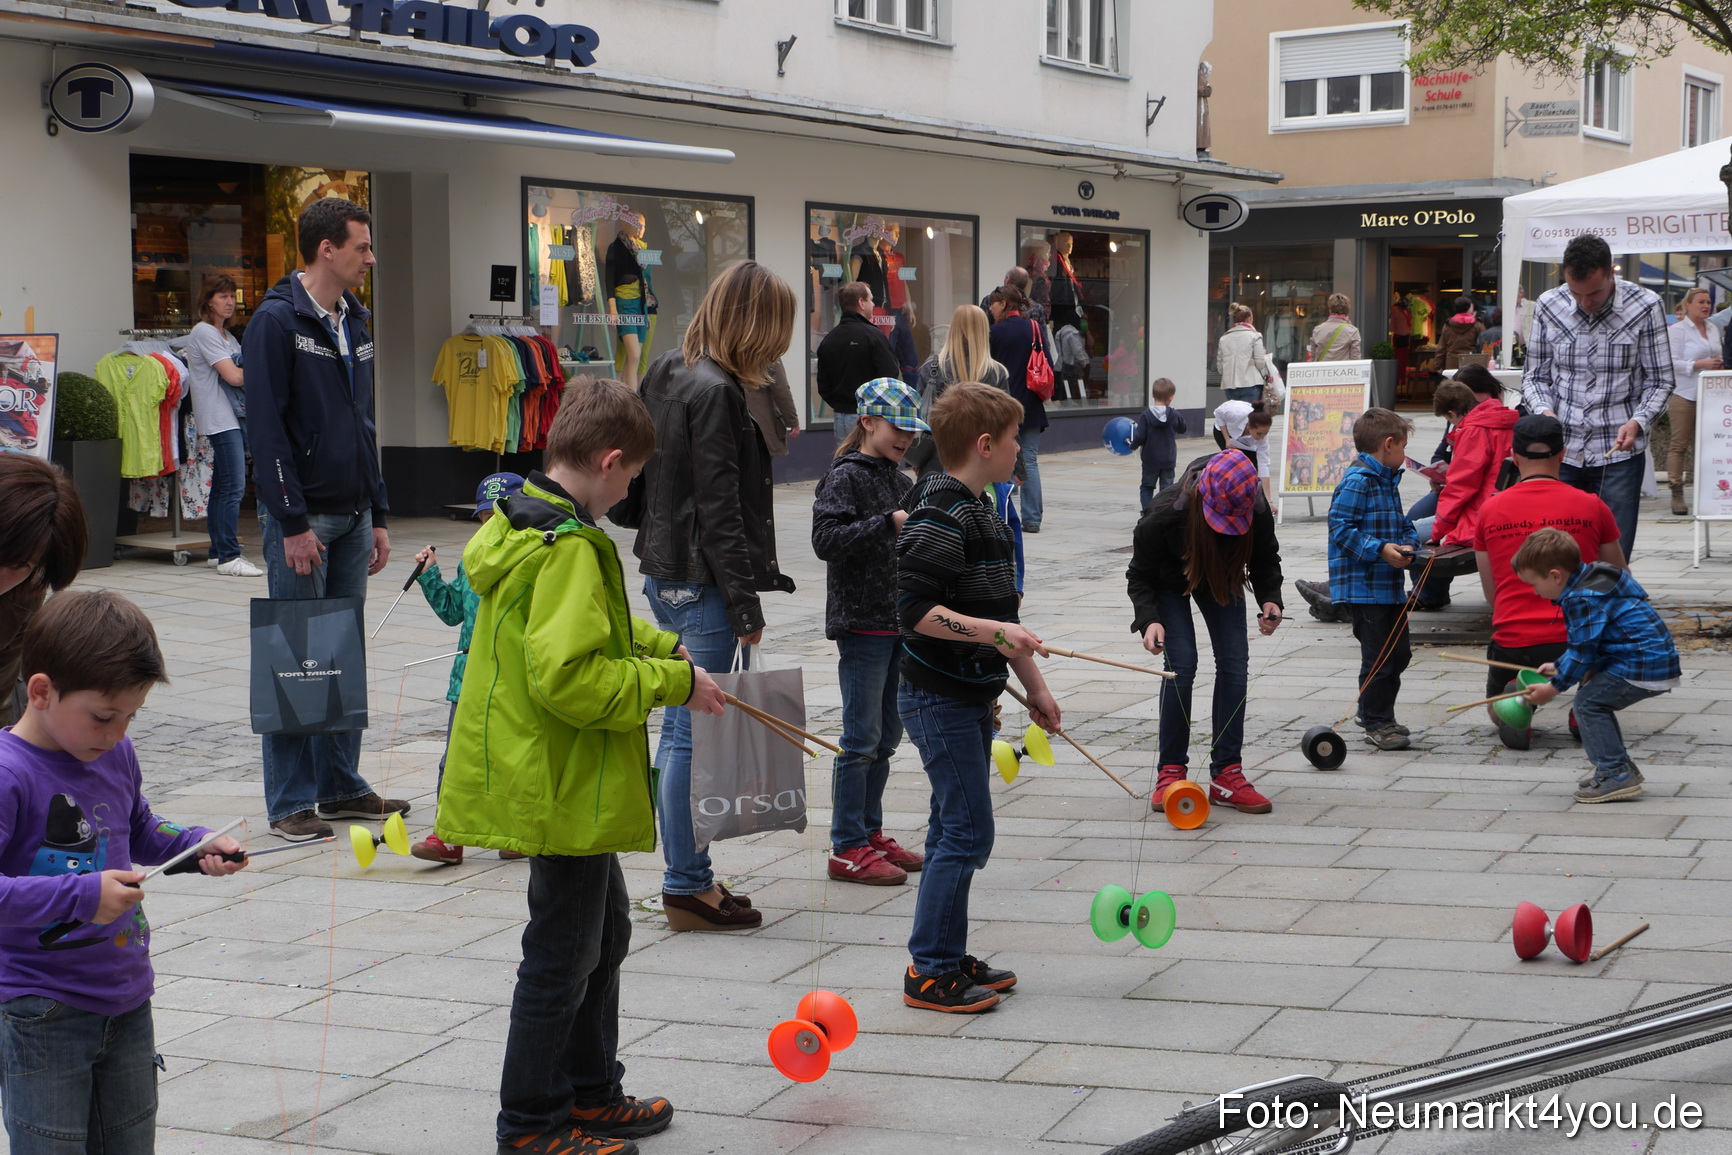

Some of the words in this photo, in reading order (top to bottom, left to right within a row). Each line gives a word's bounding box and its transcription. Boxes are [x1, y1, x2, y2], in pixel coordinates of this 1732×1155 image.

[337, 0, 600, 68] TAILOR
[1414, 71, 1473, 87] Nachhilfe-
[1424, 88, 1462, 102] Schule
[47, 114, 59, 137] 6
[1051, 205, 1081, 217] TOM
[1082, 208, 1121, 221] TAILOR
[1360, 213, 1409, 228] Marc
[1413, 209, 1476, 226] O'Polo
[550, 249, 572, 258] MUST
[640, 252, 660, 262] HAVE
[572, 314, 588, 324] THE
[588, 314, 604, 324] BEST
[616, 315, 645, 325] SUMMER
[1289, 368, 1360, 379] BRIGITTEKARL
[486, 482, 501, 500] 2
[1488, 519, 1535, 535] Comedy
[1540, 516, 1593, 528] Jonglage
[306, 669, 342, 677] TAILOR
